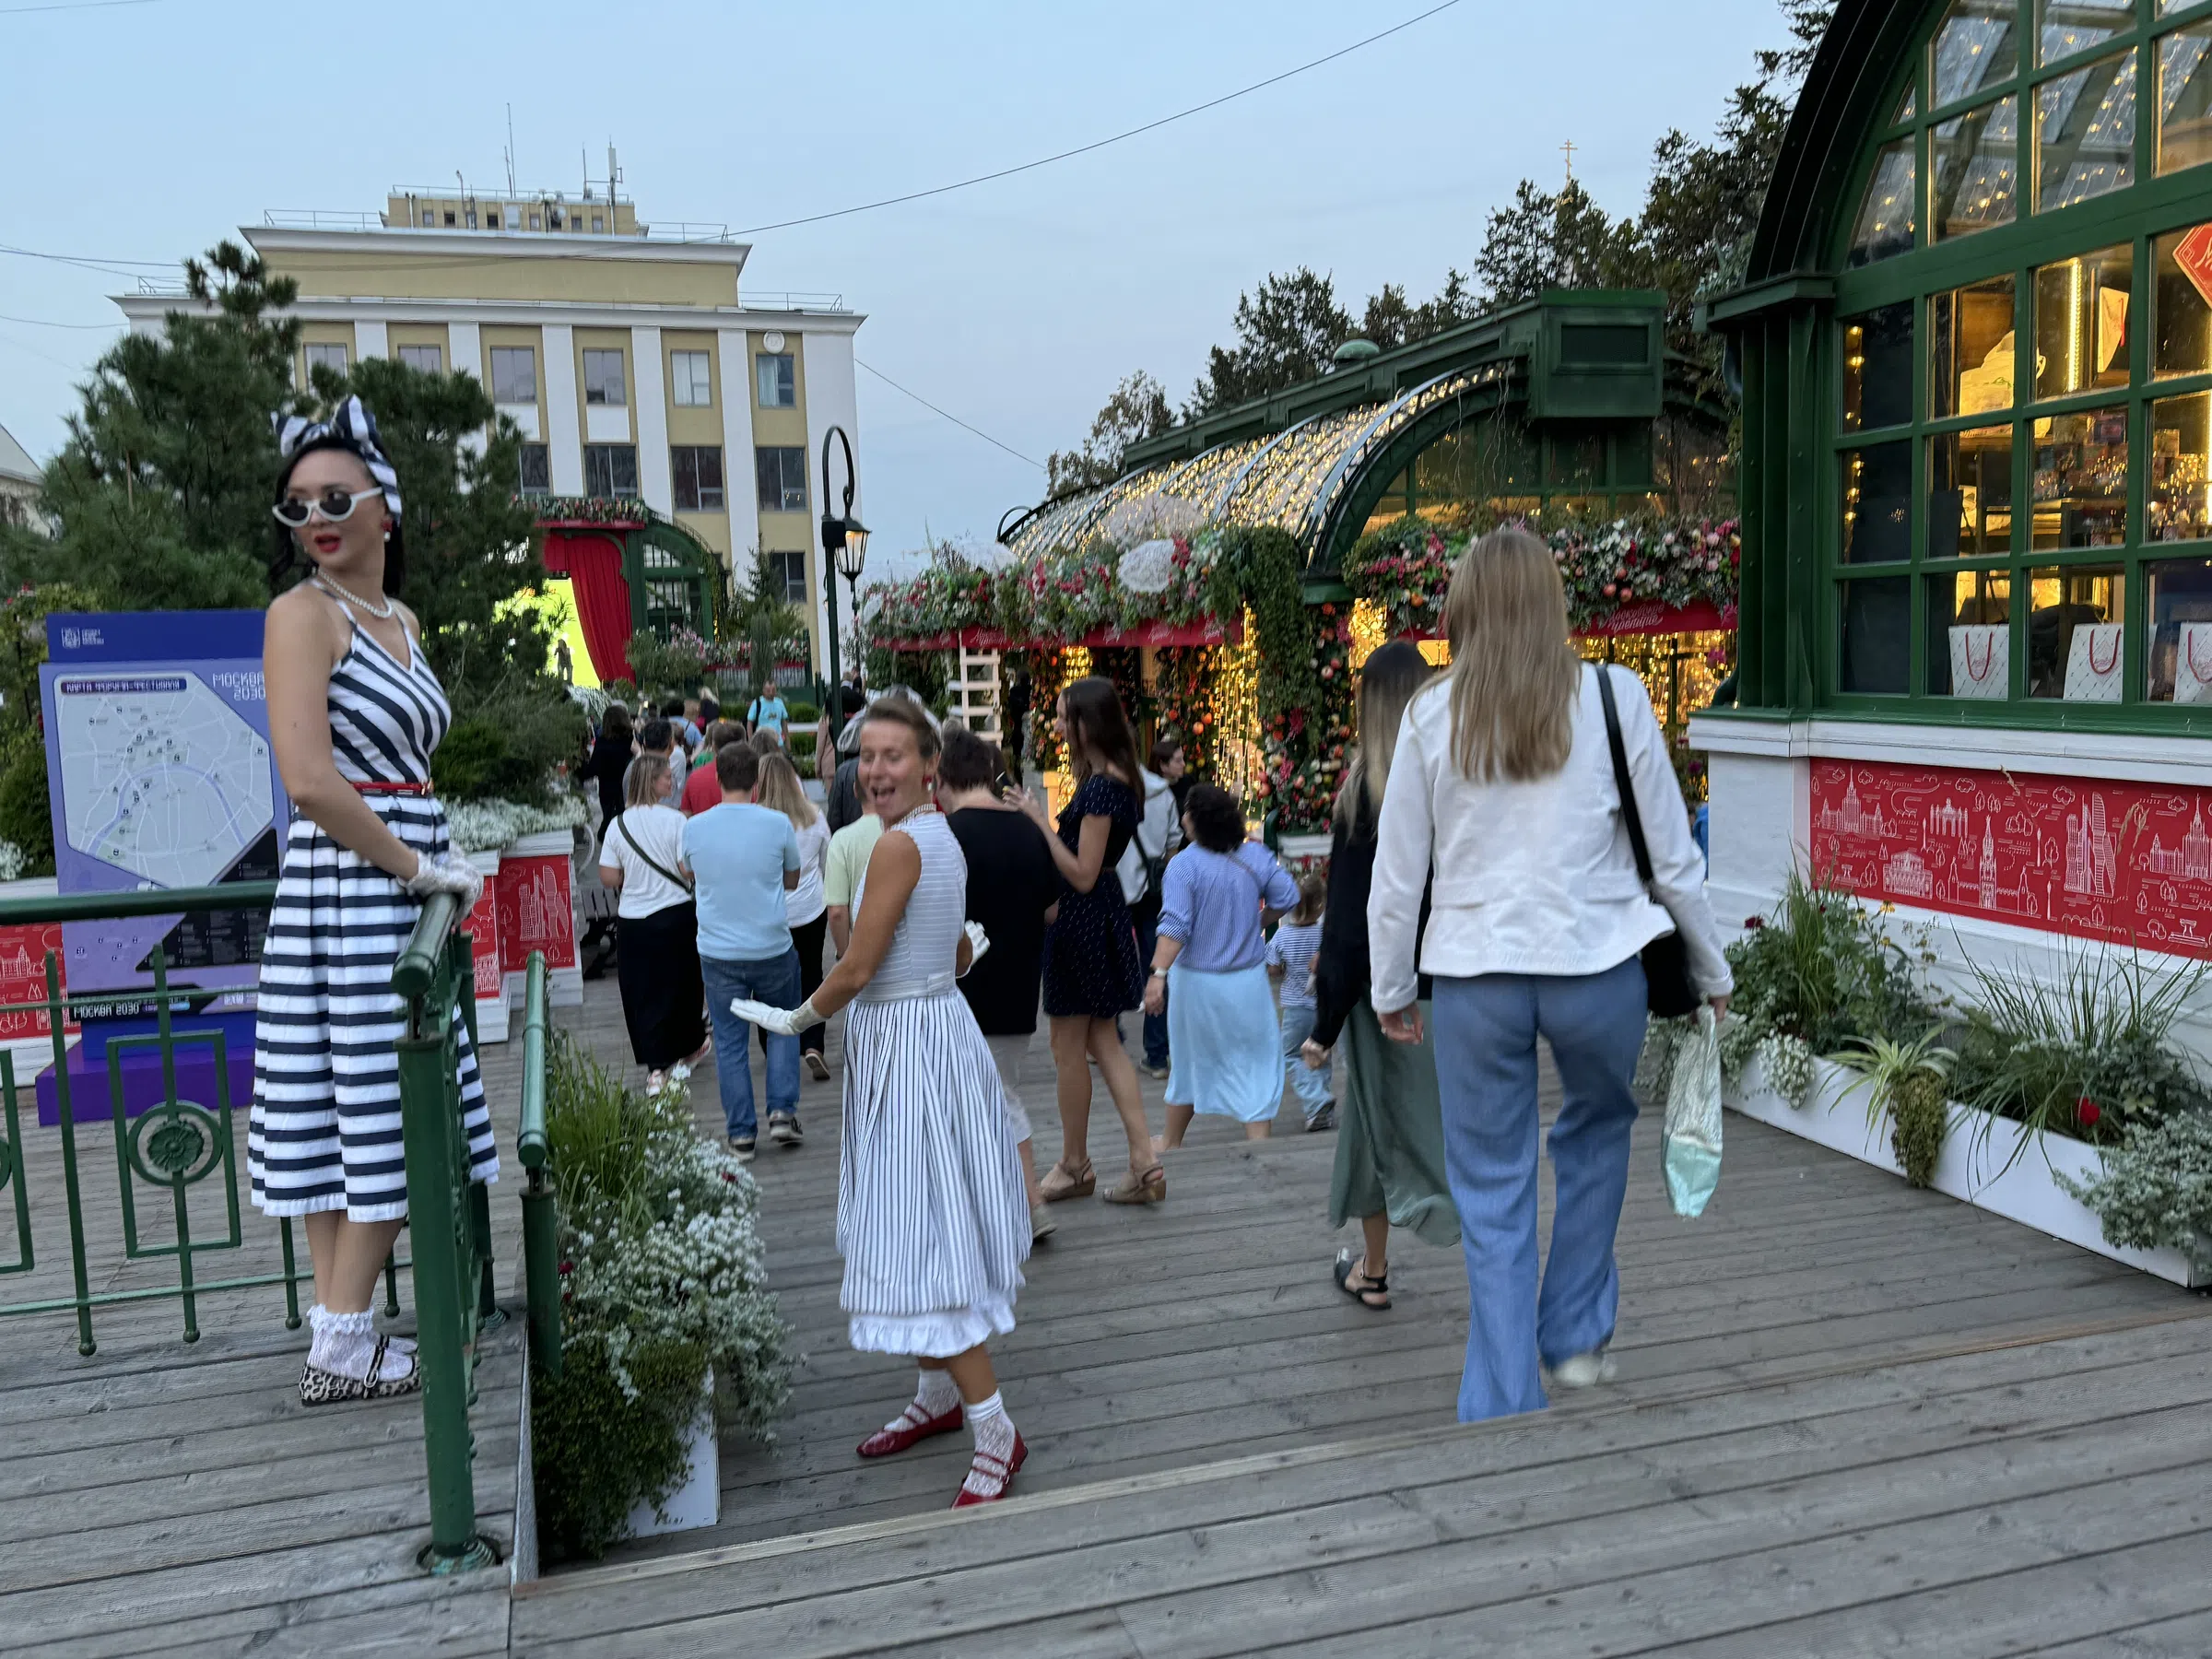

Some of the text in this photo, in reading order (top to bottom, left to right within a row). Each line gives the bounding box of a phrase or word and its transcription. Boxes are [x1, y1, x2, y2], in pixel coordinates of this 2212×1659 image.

[234, 686, 265, 700] 2030
[74, 1002, 139, 1018] МОСКВА 2030
